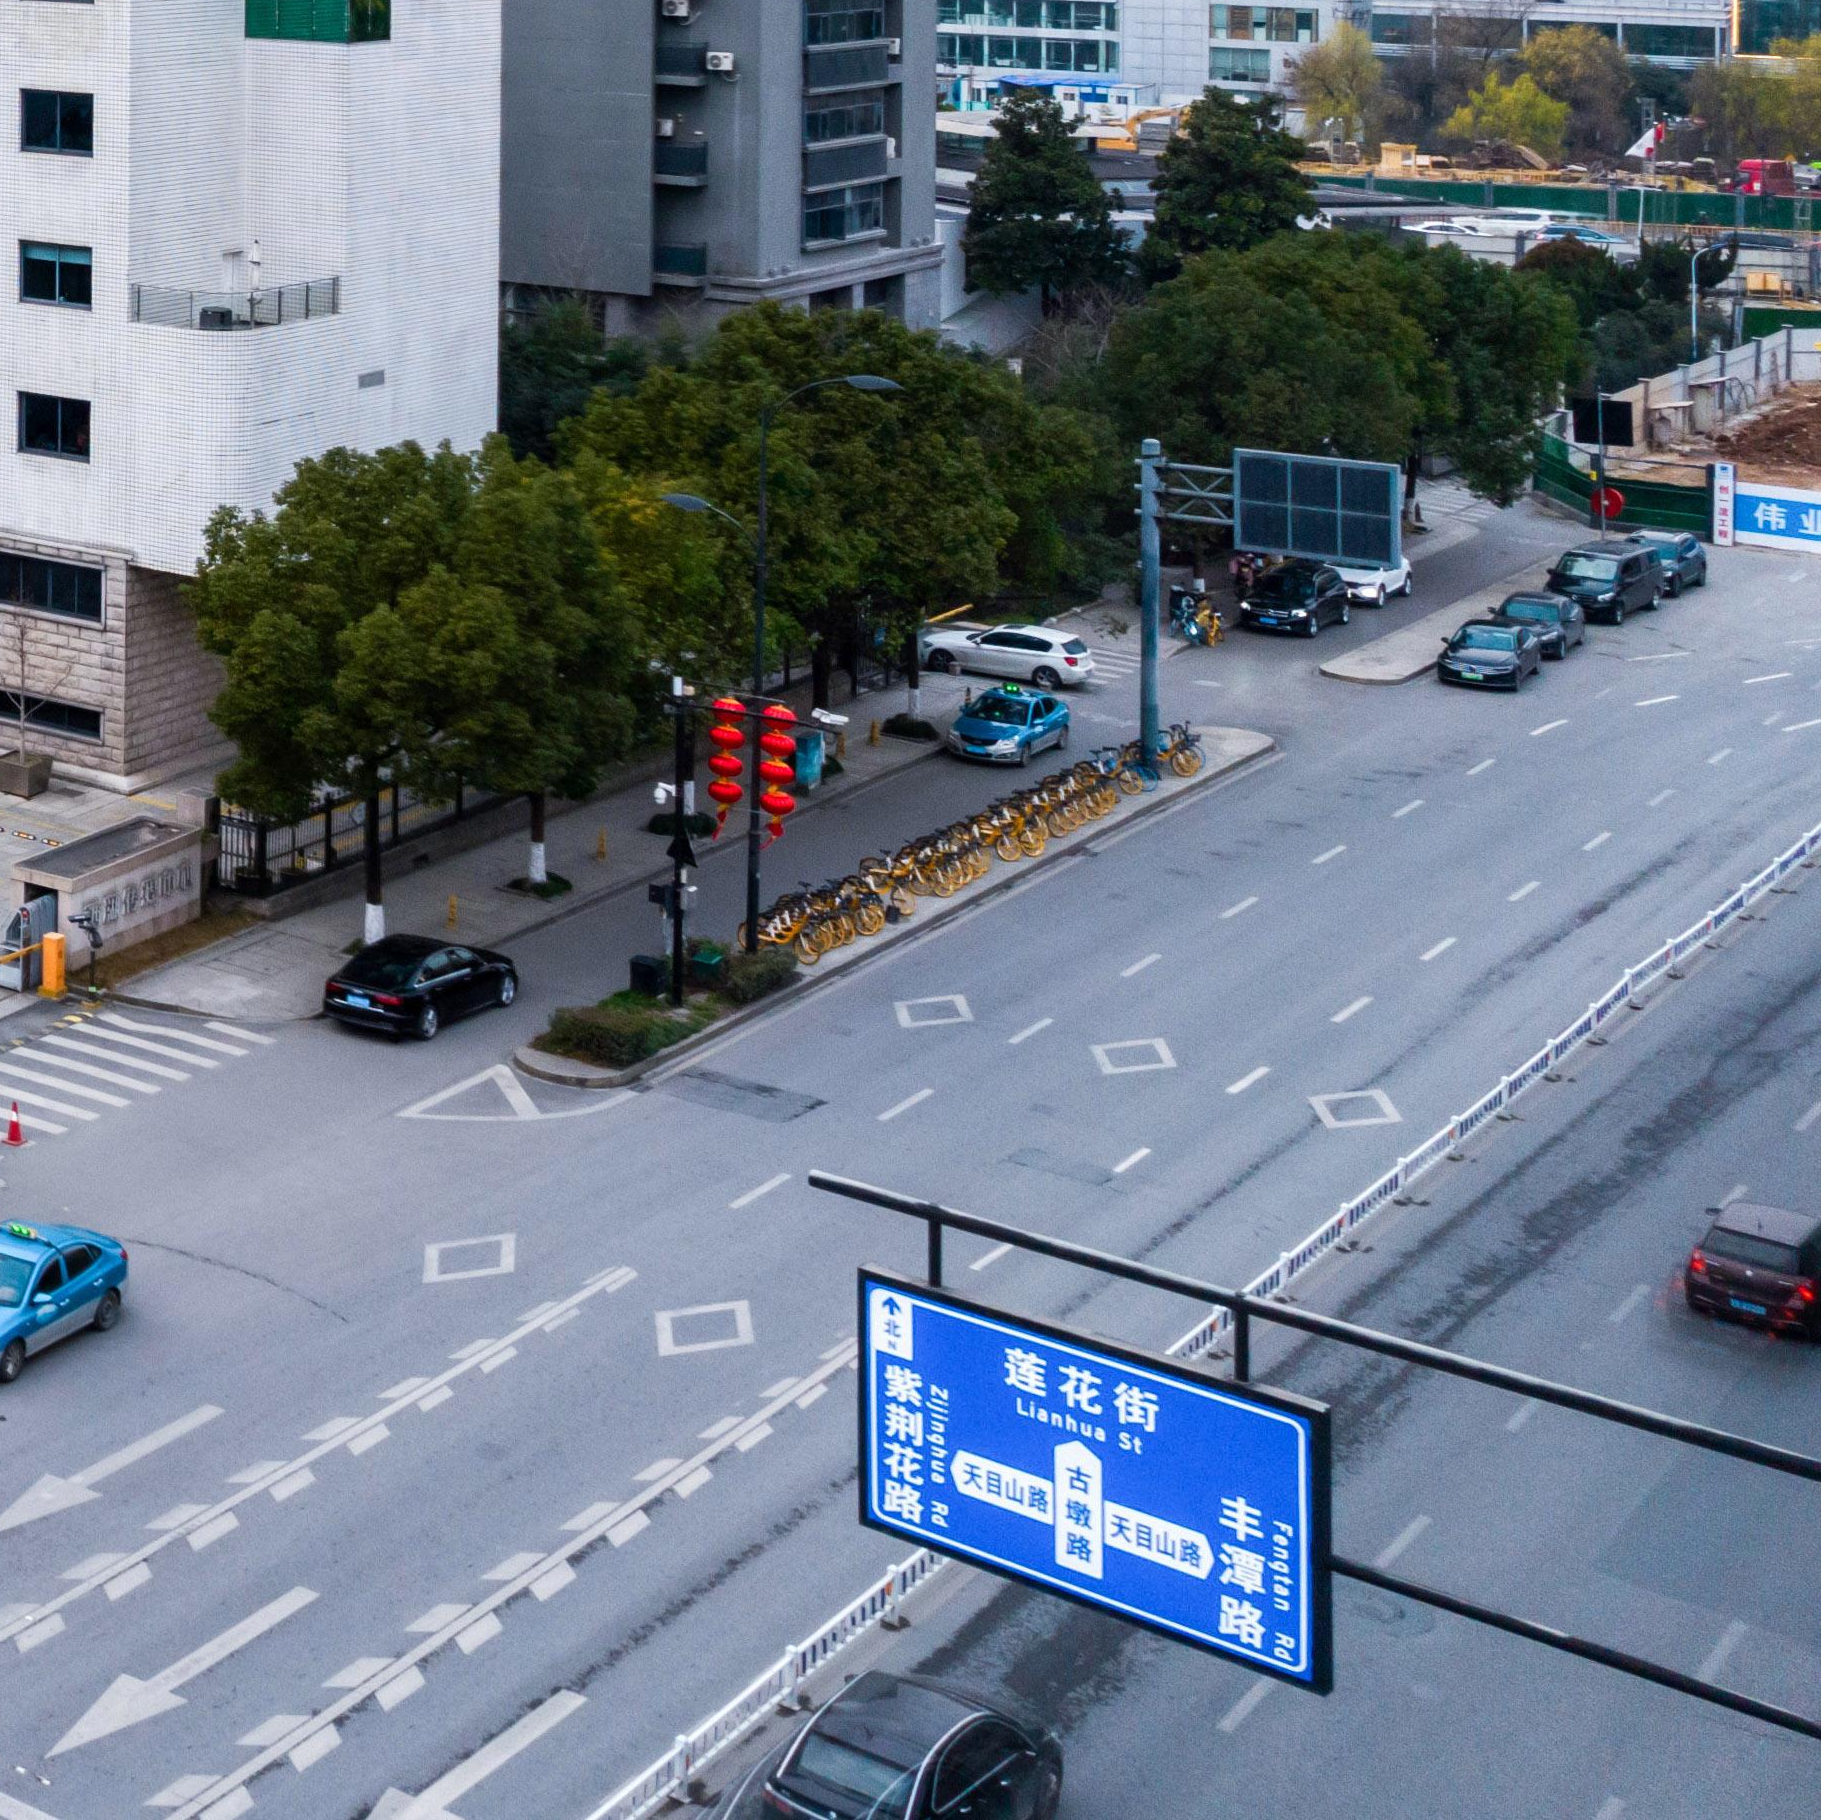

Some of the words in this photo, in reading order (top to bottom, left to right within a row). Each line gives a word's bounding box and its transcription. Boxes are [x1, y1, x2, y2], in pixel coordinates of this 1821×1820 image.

[883, 1318, 901, 1338] 北
[1003, 1347, 1160, 1433] 莲花街
[883, 1364, 925, 1525] 紫荆花路
[1016, 1397, 1106, 1443] Lianhua
[1118, 1431, 1143, 1455] St
[931, 1501, 949, 1528] Rd
[962, 1461, 1049, 1515] 天目山路
[1065, 1465, 1093, 1564] 古墩路
[1110, 1513, 1202, 1569] 天目山路
[1267, 1520, 1295, 1612] Fengtan
[1218, 1496, 1267, 1650] 丰潭路
[1273, 1632, 1296, 1663] Rd
